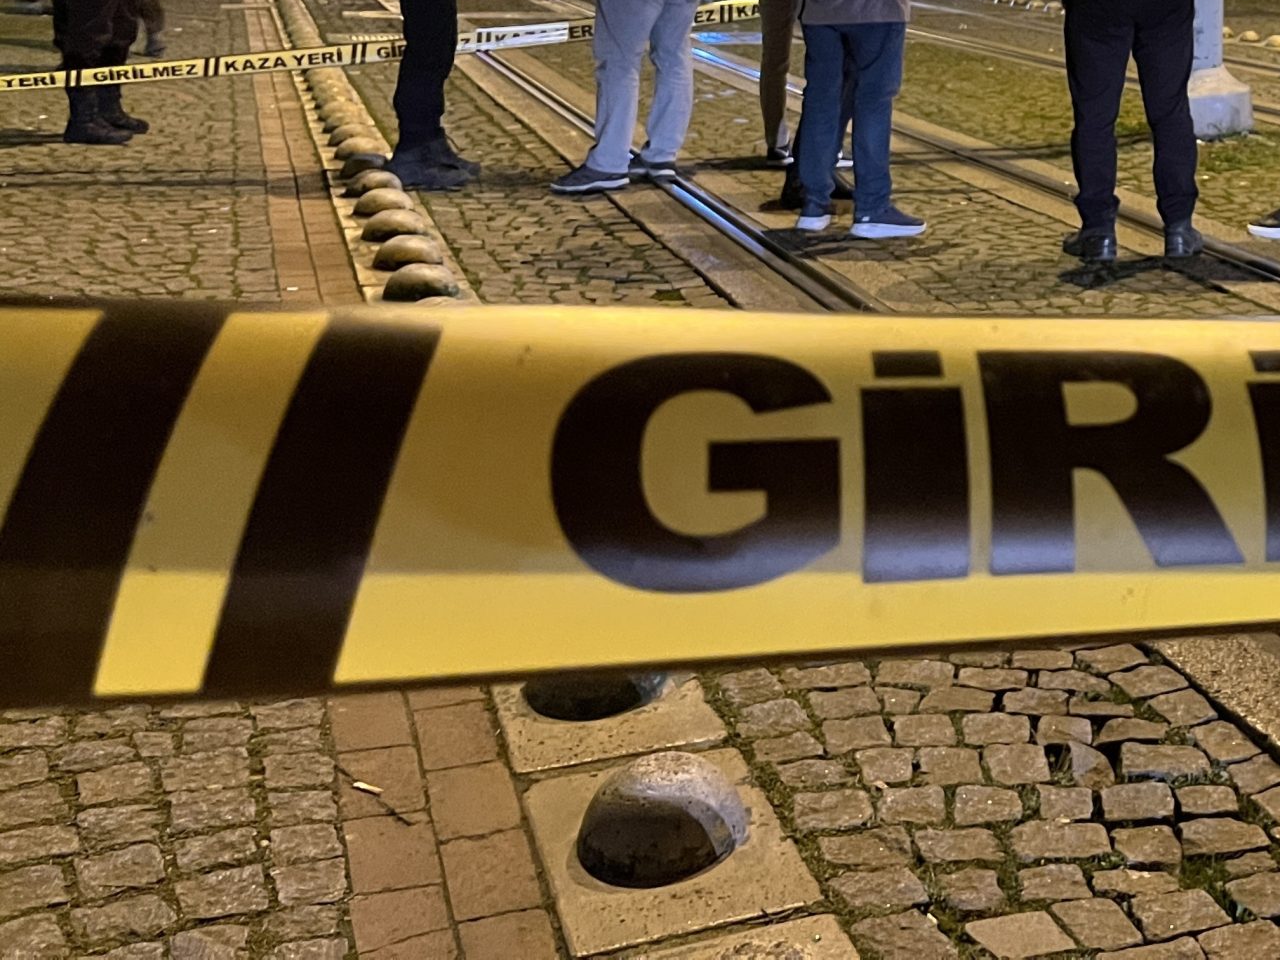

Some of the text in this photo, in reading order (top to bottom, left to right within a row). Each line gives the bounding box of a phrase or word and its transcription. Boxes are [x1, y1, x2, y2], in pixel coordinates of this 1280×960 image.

[0, 46, 344, 89] YERİ GİRİLMEZ KAZA YERİ
